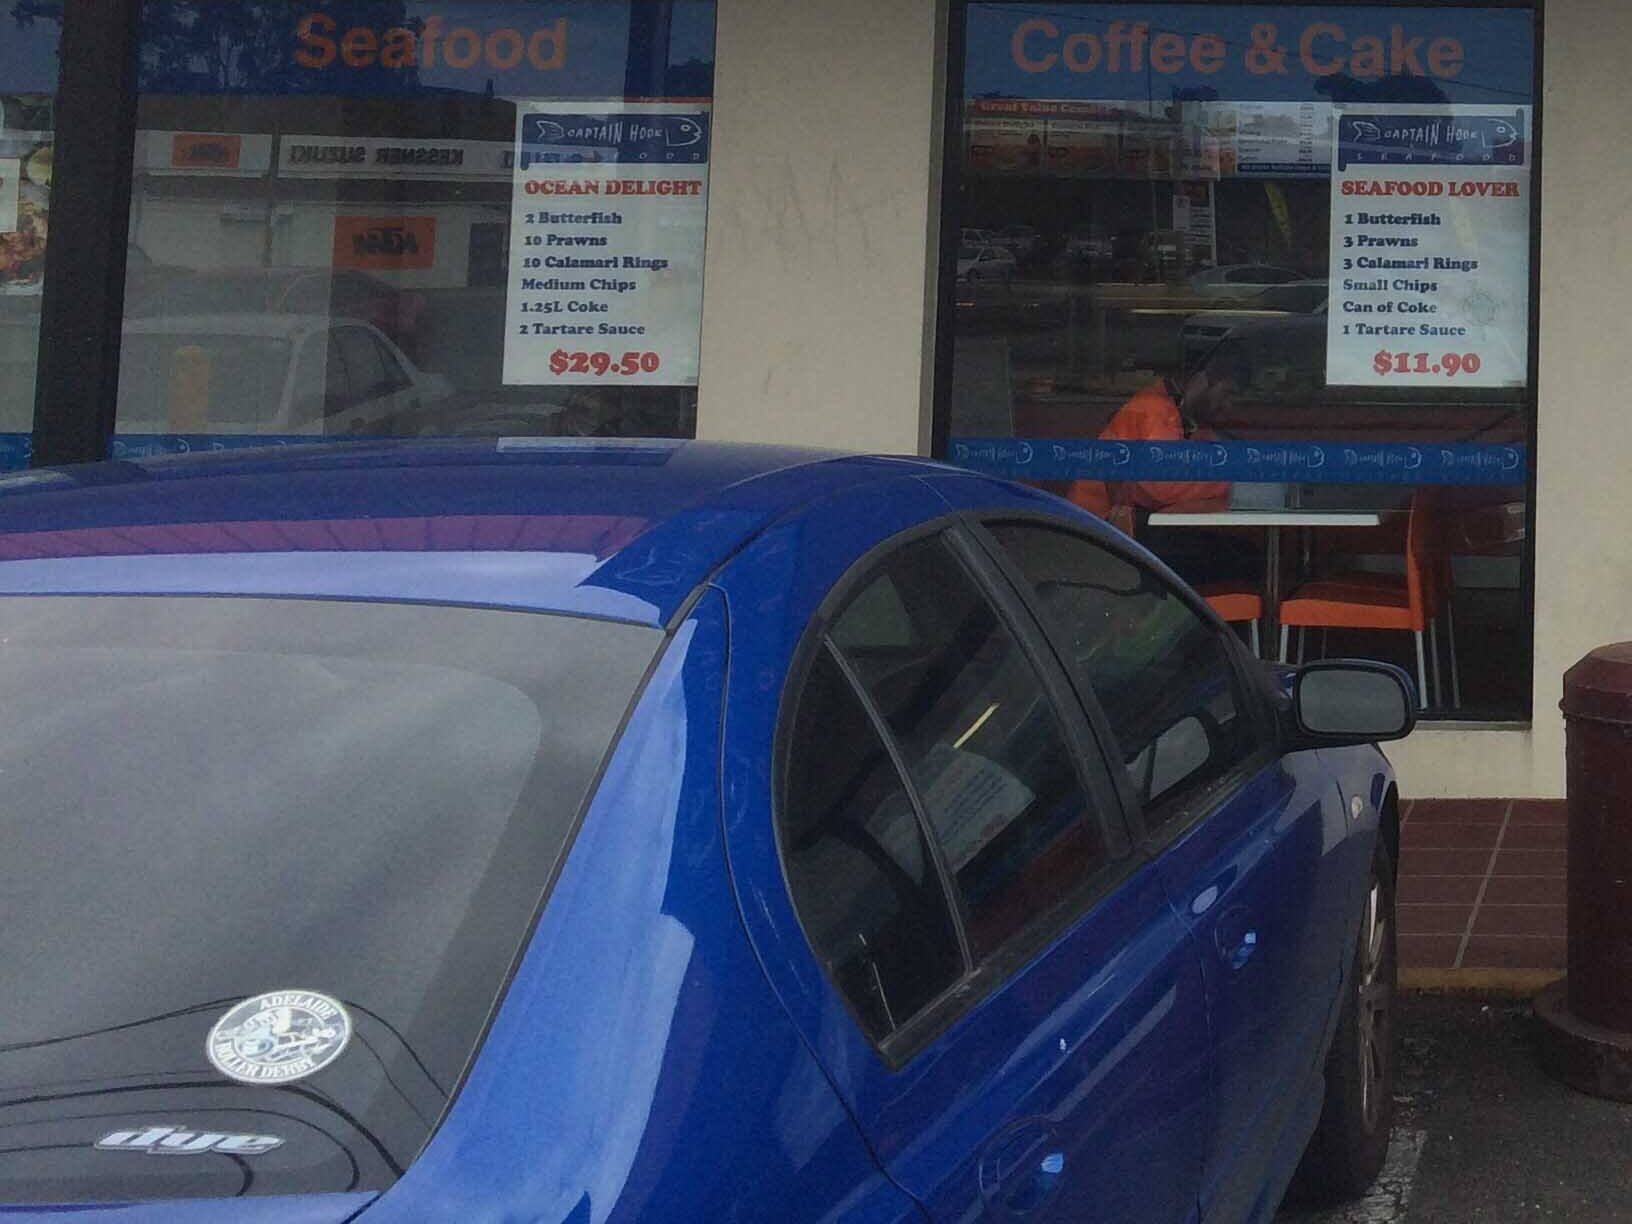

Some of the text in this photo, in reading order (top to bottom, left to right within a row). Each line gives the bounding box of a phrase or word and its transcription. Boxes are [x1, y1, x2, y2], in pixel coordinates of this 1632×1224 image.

[295, 13, 567, 70] Seafood
[1011, 18, 1465, 76] Coffee & Cake
[568, 121, 662, 144] CAPTAIN HOOK
[1384, 123, 1477, 146] CAPTAIN HOOK
[525, 180, 702, 195] OCEAN DELIGHT
[1341, 181, 1519, 197] SEAFOOD LOVER
[524, 212, 622, 224] 2 Butterfish
[1344, 213, 1441, 225] 1 Butterfish
[524, 235, 607, 246] 10 Prawns
[1343, 235, 1418, 248] 3 Prawns
[524, 256, 668, 271] 10 Calamari Rings
[1343, 257, 1478, 272] 3 Calamari Rings
[521, 279, 636, 293] Medium Chips
[1343, 279, 1437, 293] Small Chips
[521, 301, 608, 314] 1.25L Coke
[1343, 301, 1437, 313] Can of Coke
[519, 323, 645, 335] 2 Tartare Sauce
[1342, 324, 1466, 336] 1 Tartare Sauce
[549, 348, 659, 375] $29.50
[1374, 350, 1480, 376] $11.90
[260, 995, 338, 1020] ADELAIDE
[260, 1055, 317, 1078] DERBY
[97, 1126, 284, 1152] dye
